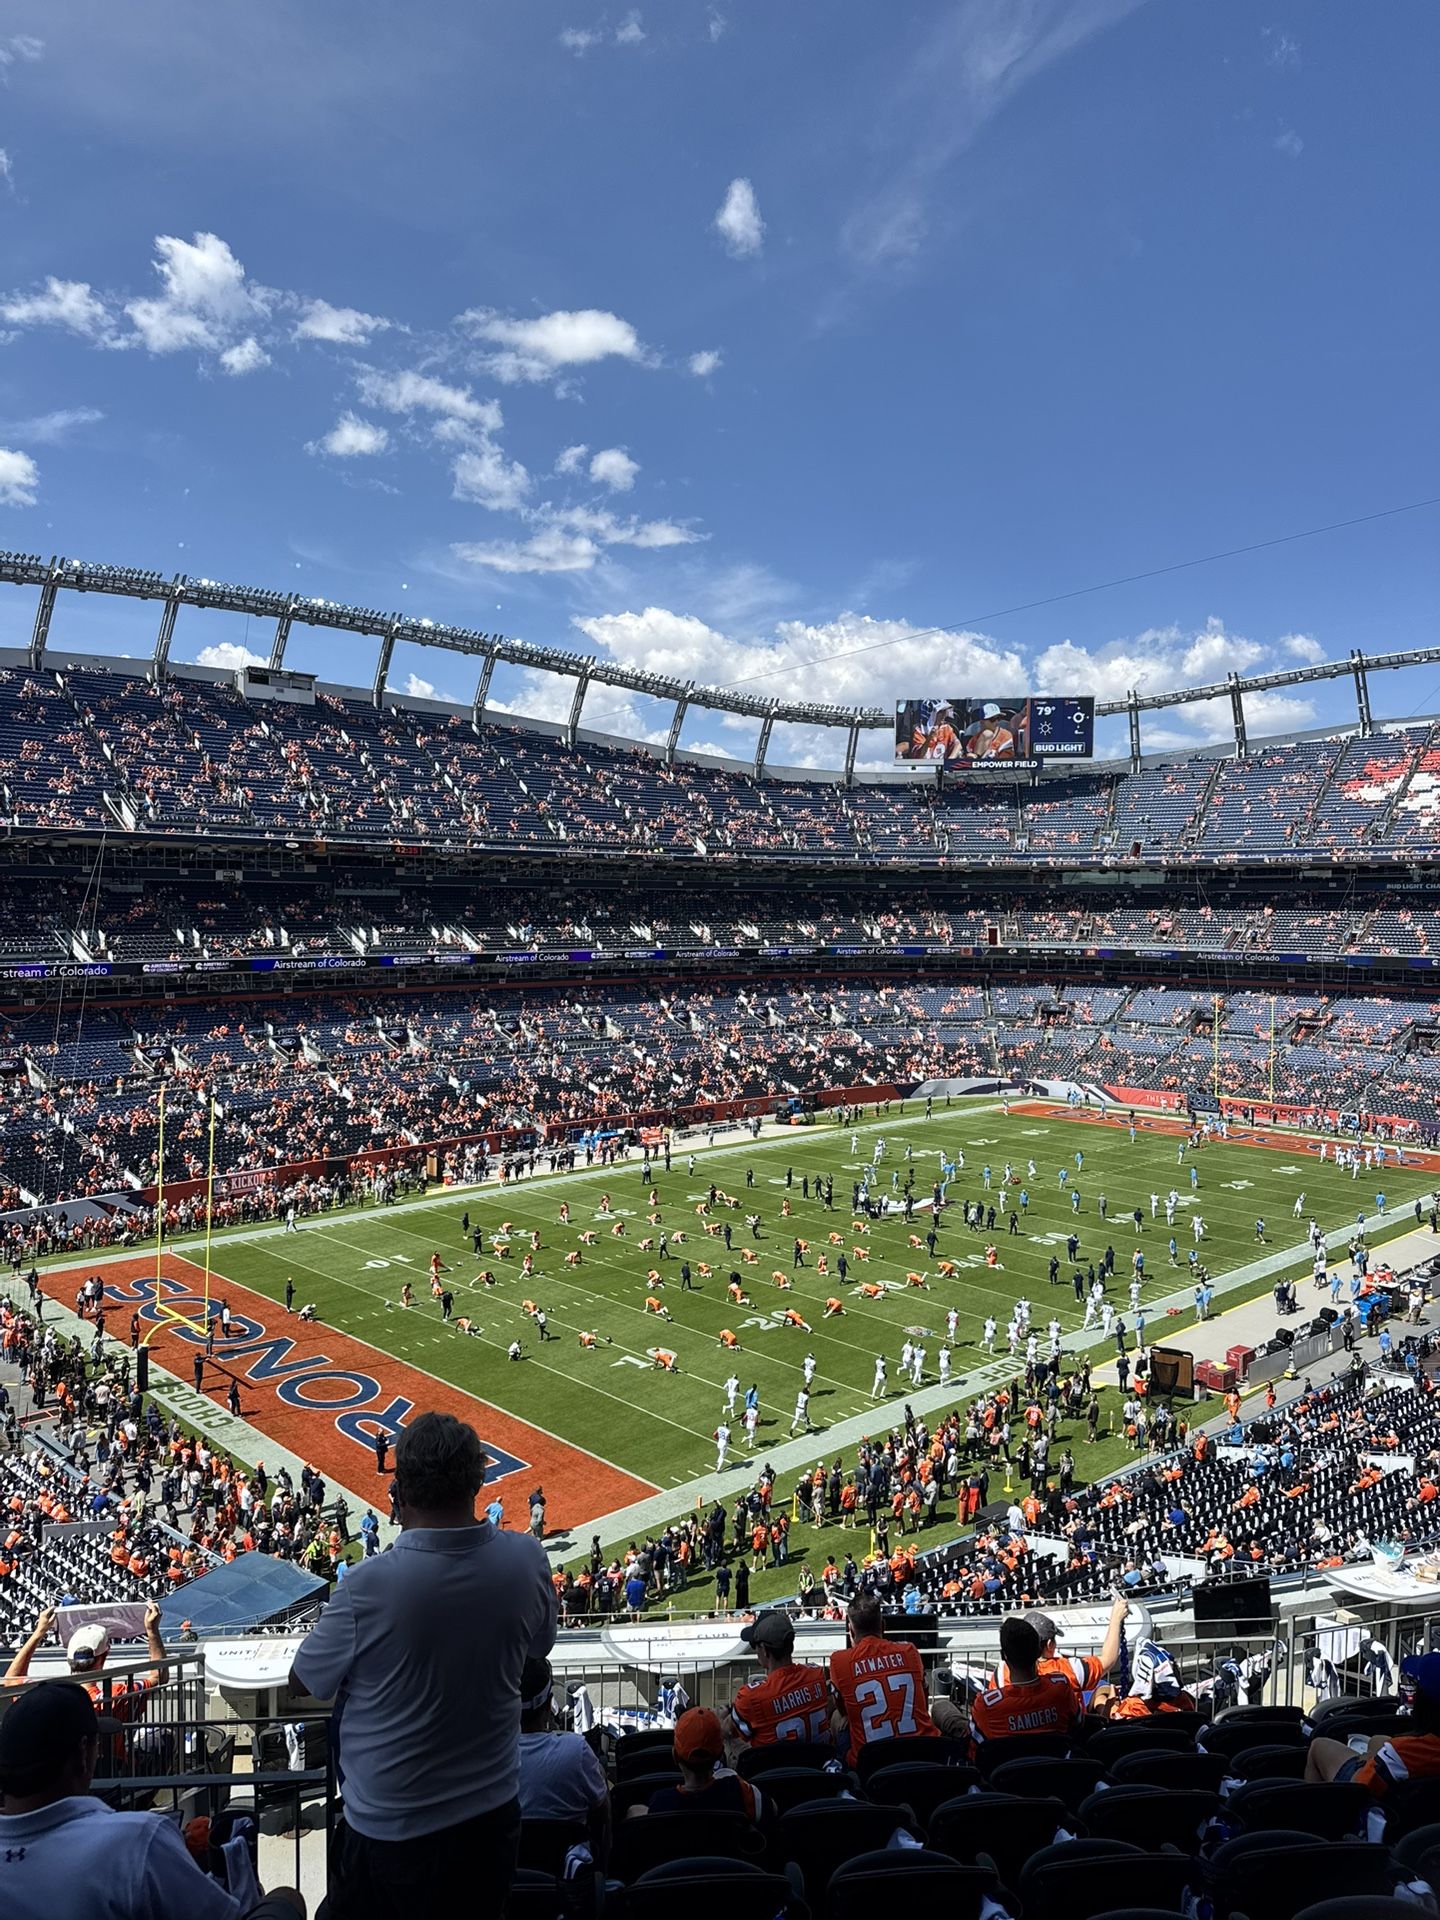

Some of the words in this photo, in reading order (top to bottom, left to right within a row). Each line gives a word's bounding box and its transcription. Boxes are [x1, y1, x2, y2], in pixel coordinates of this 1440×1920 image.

[1036, 706, 1056, 715] 79°
[1035, 744, 1055, 752] BUD
[1056, 744, 1083, 752] LIGHT
[972, 761, 1013, 769] EMPOWER
[1015, 760, 1038, 768] FIELD
[675, 950, 704, 958] Airstream
[713, 949, 740, 957] Colorado
[836, 946, 866, 955] Airstream
[867, 946, 875, 955] of
[876, 946, 905, 955] Colorado
[495, 954, 527, 963] Airstream
[529, 953, 538, 961] of
[538, 953, 569, 962] Colorado
[1196, 952, 1233, 962] Airstream
[1235, 952, 1244, 961] of
[1244, 953, 1280, 962] Colorado
[273, 960, 315, 969] Airstream
[317, 959, 326, 967] of
[328, 958, 367, 967] Colorado
[44, 967, 57, 977] of
[59, 966, 108, 976] Colorado
[1028, 1231, 1074, 1246] 50
[854, 1653, 905, 1676] ATWATER
[773, 1687, 811, 1715] HARRIS
[982, 1689, 1003, 1707] 0
[854, 1672, 918, 1743] 27
[1008, 1707, 1059, 1731] SANDERS
